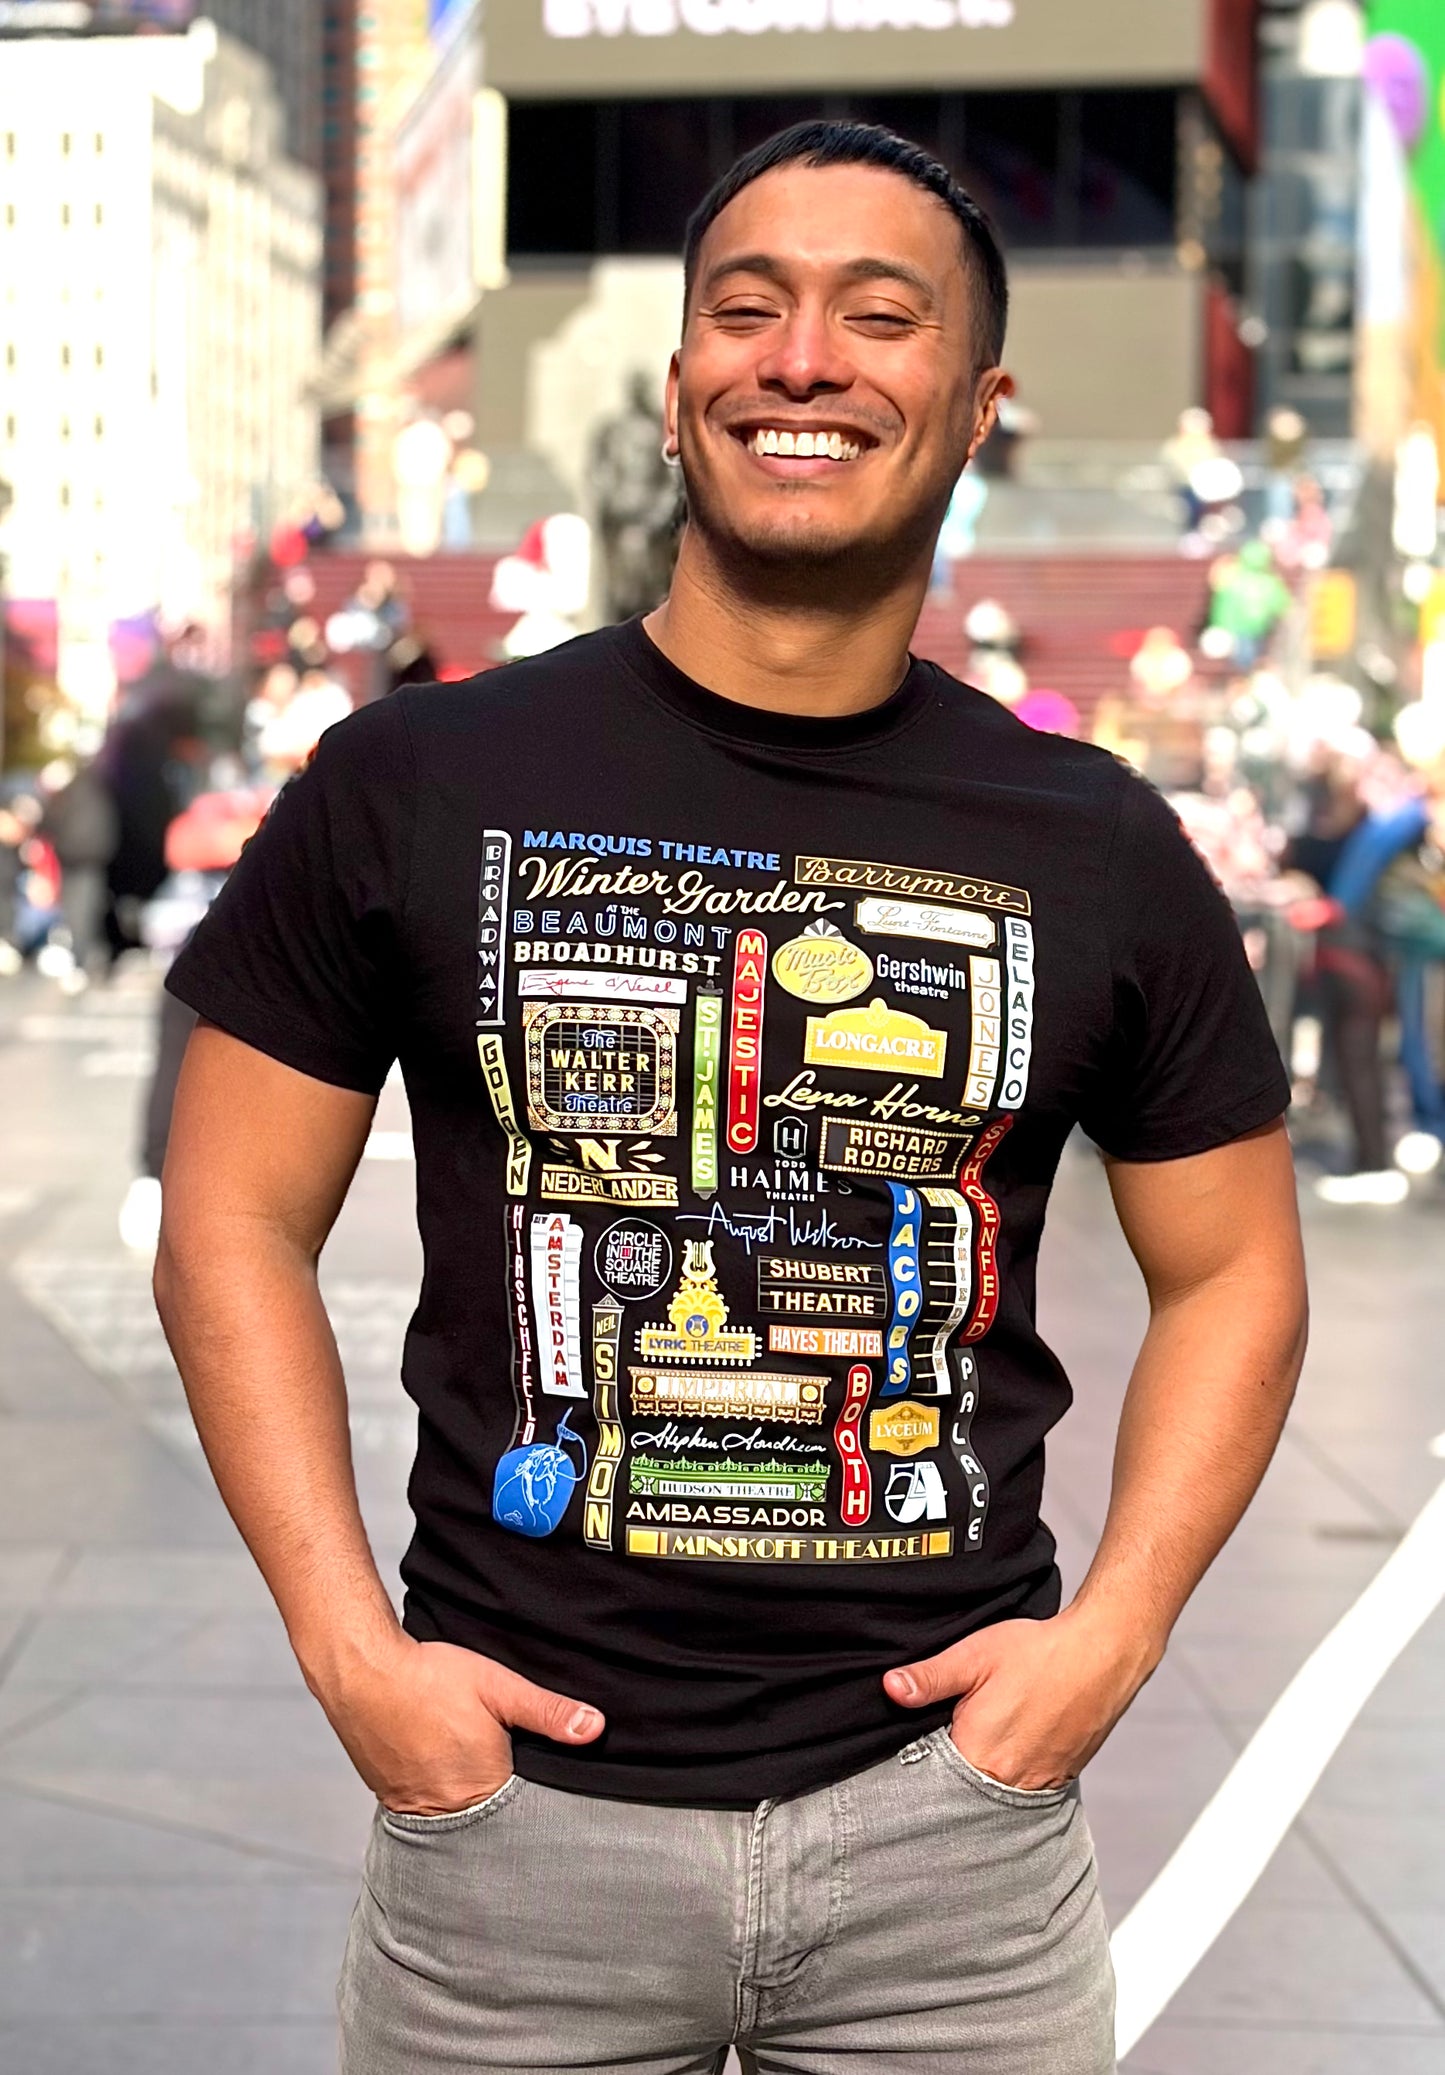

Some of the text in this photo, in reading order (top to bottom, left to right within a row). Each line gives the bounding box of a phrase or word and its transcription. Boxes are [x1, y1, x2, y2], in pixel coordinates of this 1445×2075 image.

[523, 830, 781, 872] MARQUIS THEATRE
[518, 856, 846, 914] Winter Garden
[801, 858, 1025, 909] Barrymore
[606, 904, 639, 916] AT THE
[479, 845, 502, 1013] BROADWAY
[513, 909, 732, 949] BEAUMONT
[514, 941, 721, 976] BROADHURST
[786, 948, 858, 972] Music
[877, 953, 966, 989] Gershwin
[799, 968, 864, 994] Box
[895, 981, 949, 999] theatre
[1005, 922, 1030, 1102] BELASCO
[582, 1030, 617, 1048] The
[730, 935, 764, 1144] MAJESTIC
[815, 1029, 937, 1060] LONGACRE
[972, 964, 995, 1102] JONES
[551, 1050, 650, 1072] WALTER
[565, 1072, 635, 1092] KERR
[564, 1093, 636, 1113] Theatre
[763, 1070, 983, 1126] Lena Horne
[483, 1040, 527, 1190] GOLDEN
[575, 1138, 623, 1171] N
[850, 1128, 948, 1154] RICHARD
[775, 1160, 806, 1168] TODD
[845, 1148, 943, 1173] RODGERS
[541, 1171, 678, 1200] NEDERLANDER
[731, 1166, 852, 1195] HAIMES
[766, 1191, 815, 1202] THEATRE
[609, 1231, 662, 1247] CIRCLE
[675, 1201, 883, 1255] August Wilson
[964, 1125, 1004, 1338] SCHOENFELD
[605, 1259, 660, 1274] SQUARE
[607, 1244, 662, 1262] IN THE
[604, 1271, 660, 1287] THEATRE
[769, 1259, 872, 1283] SHUBERT
[889, 1189, 920, 1384] JACOBS
[548, 1217, 569, 1386] AMSTERDAM
[769, 1290, 874, 1315] THEATRE
[513, 1205, 536, 1445] HIRSCHFELD
[596, 1316, 616, 1337] NEIL
[649, 1338, 745, 1353] LYRIC THEATRE
[772, 1327, 881, 1356] HAYES THEATER
[667, 1377, 796, 1402] IMPERIAL
[588, 1343, 621, 1540] SIMON
[631, 1422, 719, 1453] Stephen
[839, 1372, 867, 1515] BOOTH
[876, 1421, 933, 1438] LYCEUM
[952, 1356, 985, 1541] PALACE
[662, 1483, 794, 1497] HUDSON THEATRE
[626, 1501, 827, 1527] AMBASSADOR
[672, 1535, 921, 1559] MINSKOFF THEATRE
